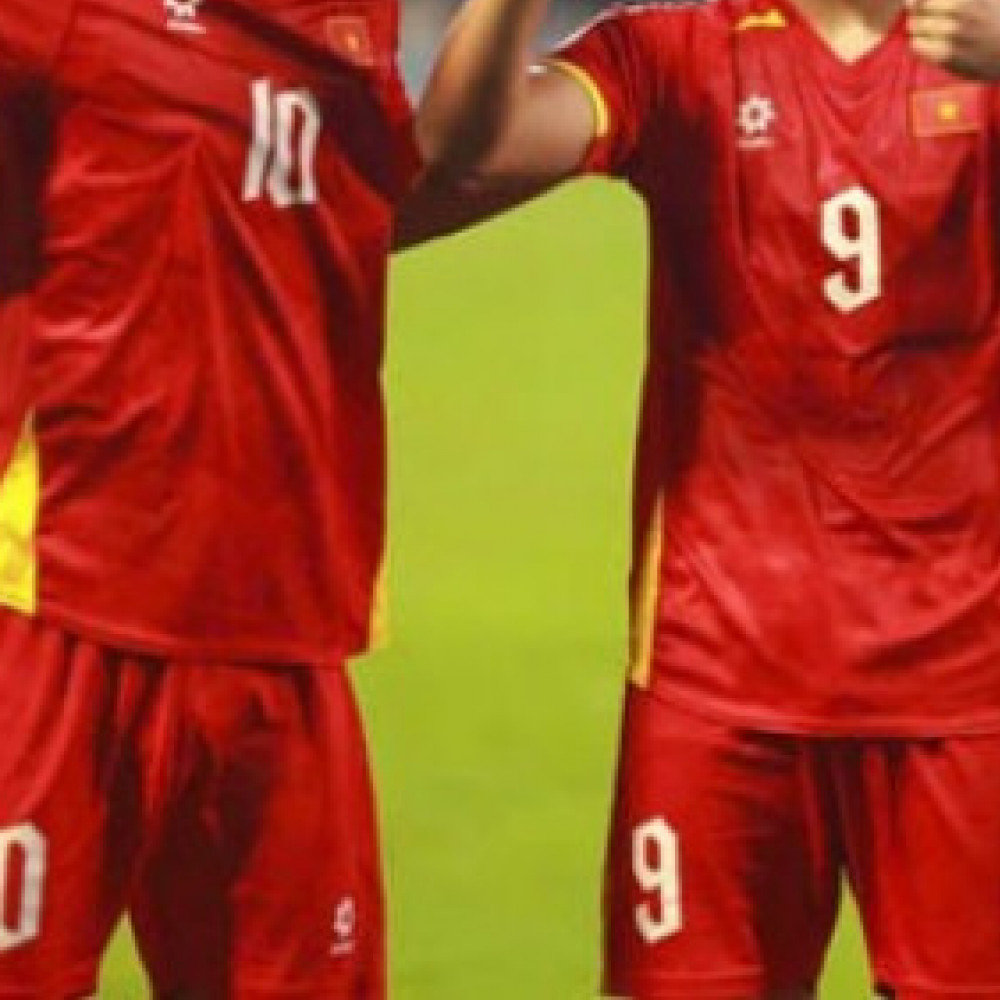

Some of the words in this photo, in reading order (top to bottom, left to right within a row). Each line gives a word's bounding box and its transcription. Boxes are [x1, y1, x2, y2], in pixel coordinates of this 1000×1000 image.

[242, 79, 321, 207] 10
[821, 187, 882, 312] 9
[631, 817, 683, 943] 9
